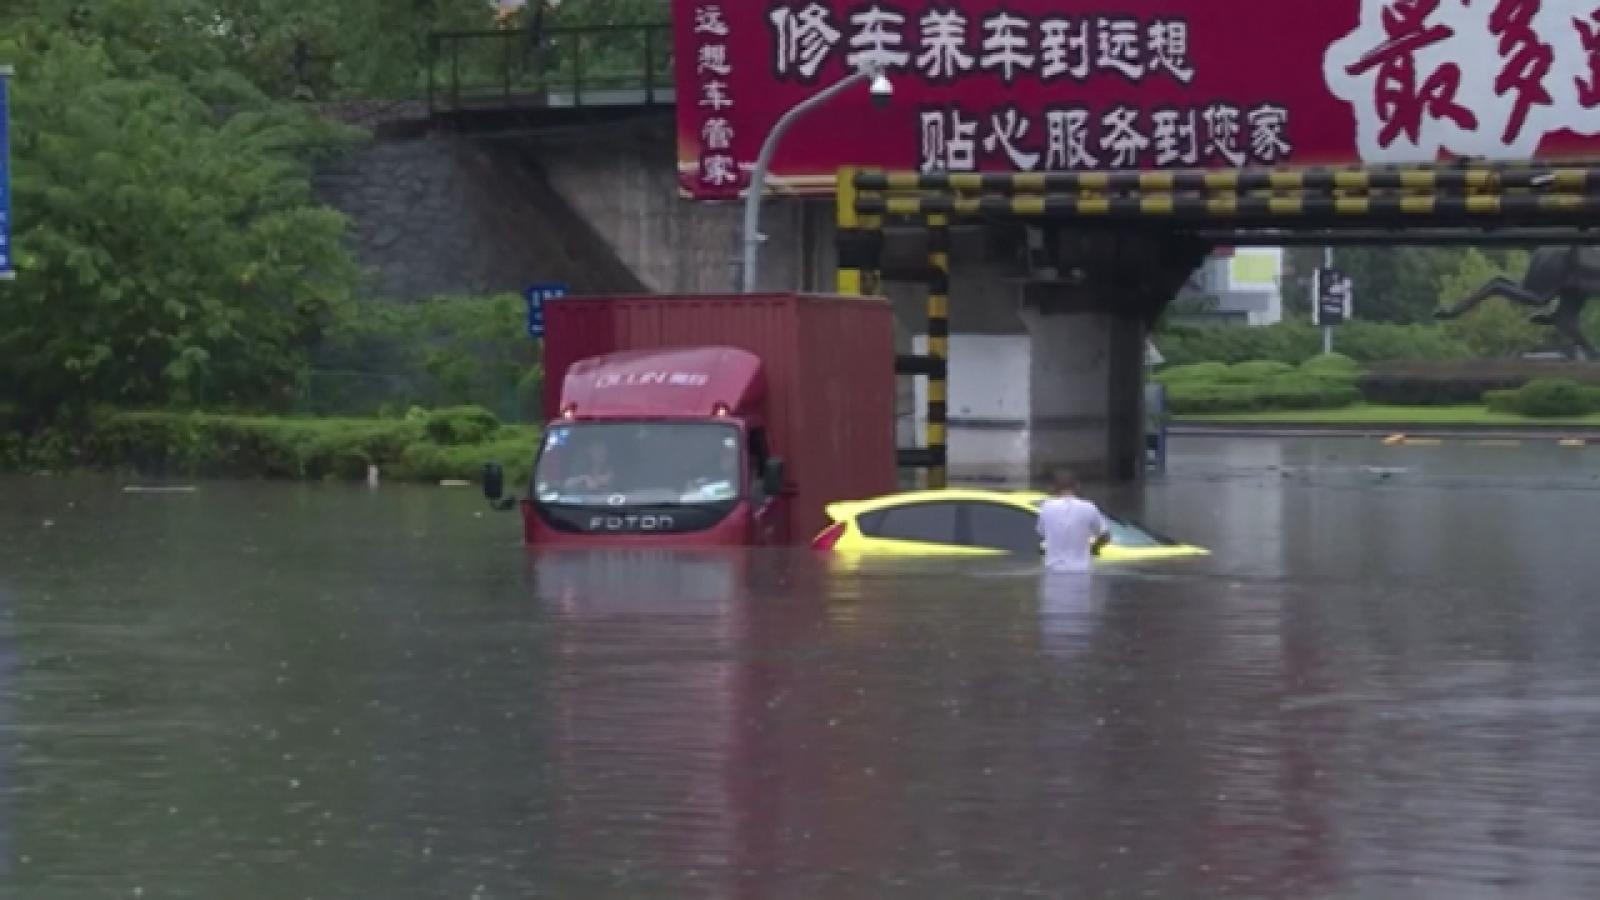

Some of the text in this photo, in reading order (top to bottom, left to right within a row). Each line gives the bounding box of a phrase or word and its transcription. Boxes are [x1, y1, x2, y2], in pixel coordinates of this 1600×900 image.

[769, 2, 1195, 82] 修车养车到远想
[694, 4, 738, 186] 远想车管家
[920, 104, 1292, 174] 贴心服务到您家
[589, 514, 674, 531] FOTON
